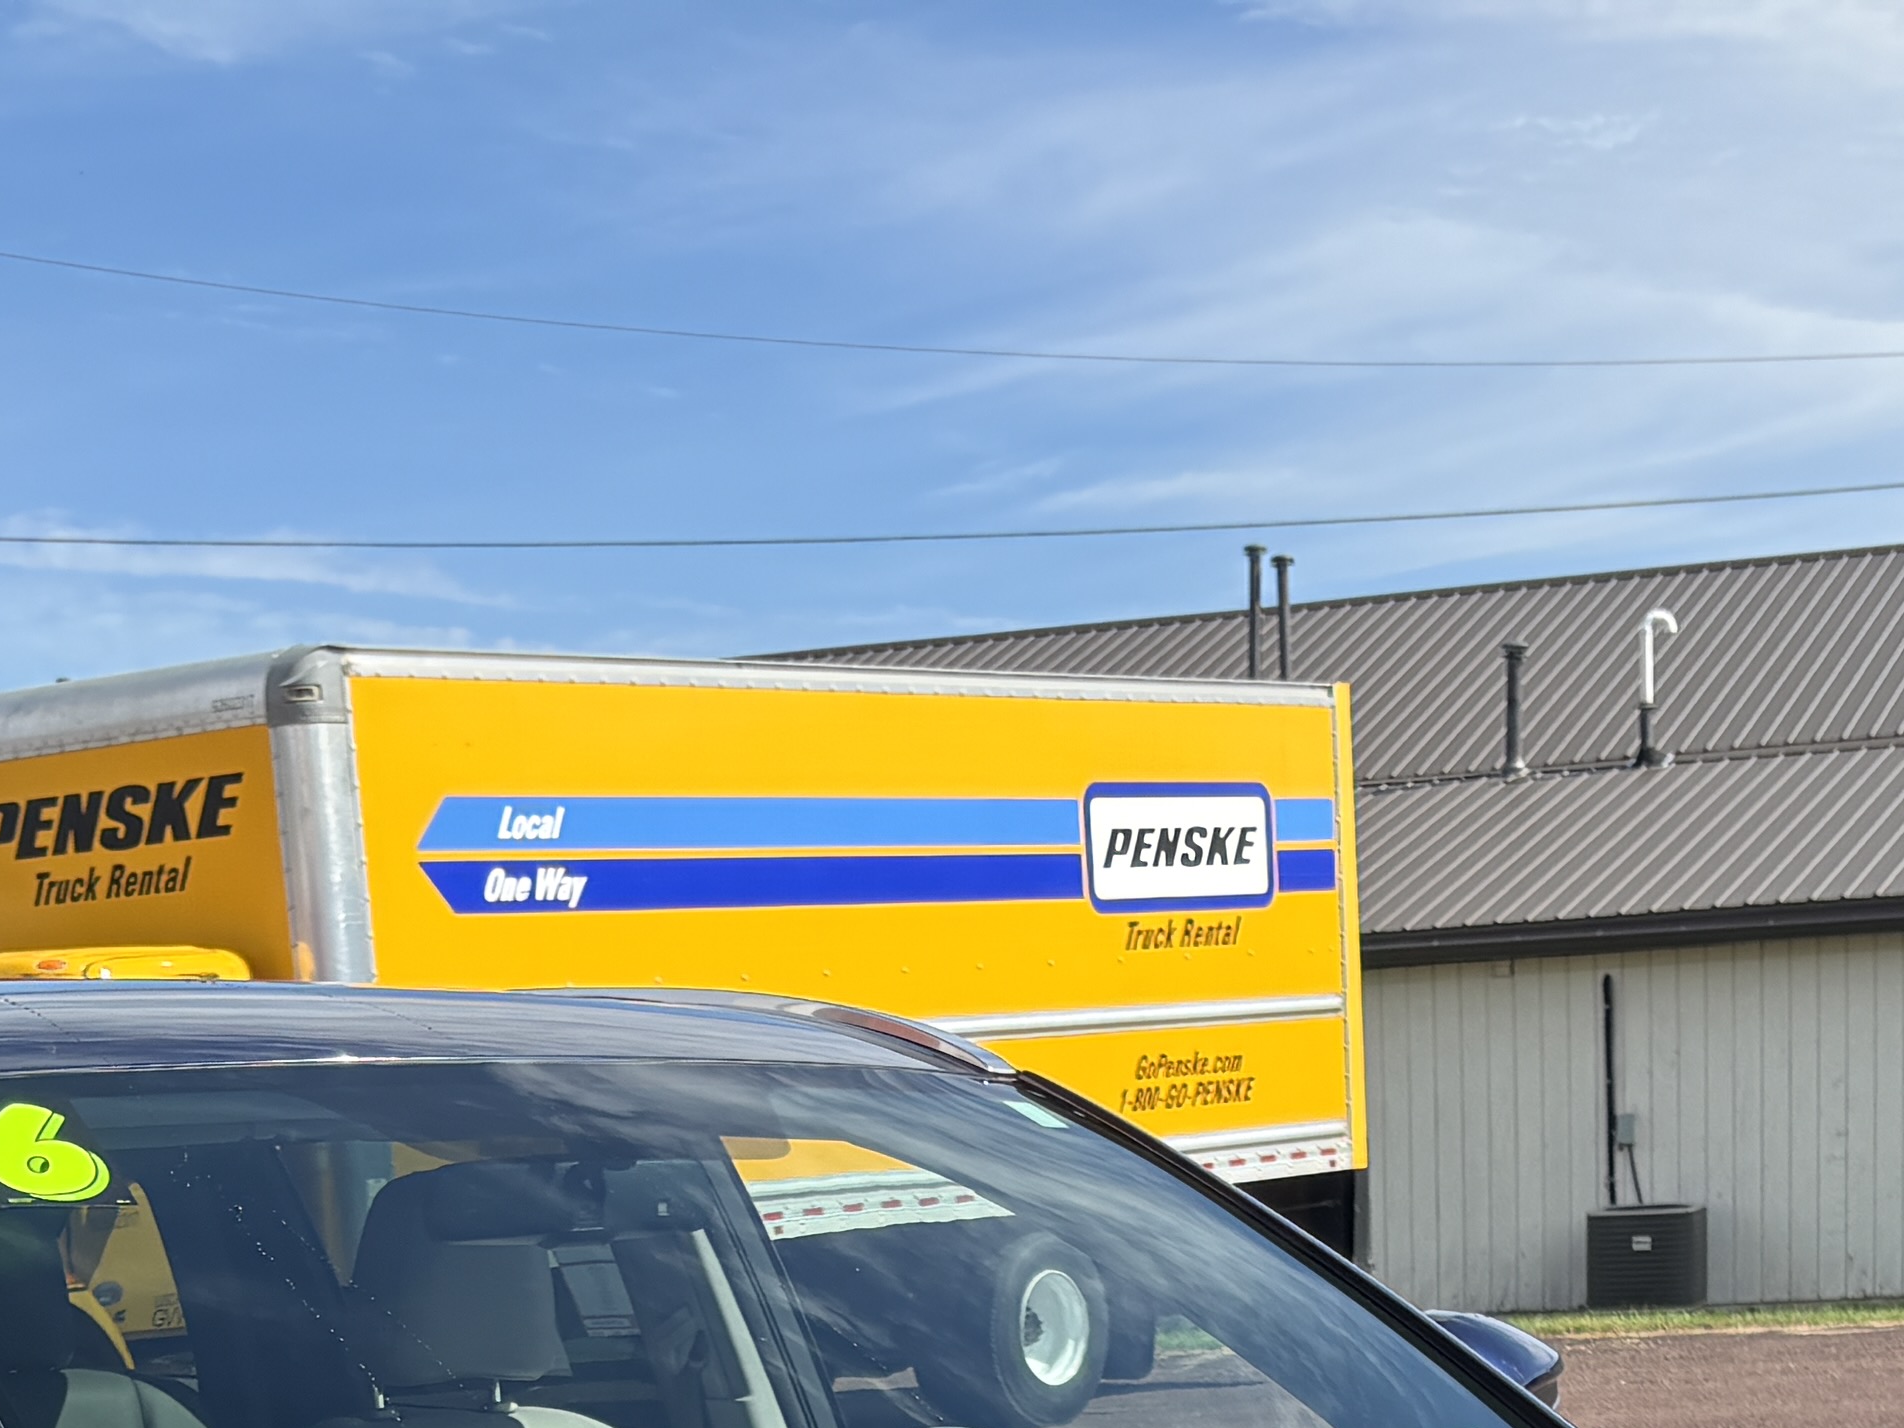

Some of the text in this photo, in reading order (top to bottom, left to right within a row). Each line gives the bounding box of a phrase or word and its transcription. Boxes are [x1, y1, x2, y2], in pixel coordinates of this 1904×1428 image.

[497, 805, 566, 841] Local
[1103, 826, 1258, 869] PENSKE
[33, 855, 193, 907] Truck Rental
[483, 867, 589, 908] One Way
[1124, 916, 1243, 951] Truck Rental
[1134, 1050, 1244, 1081] GoPenske.com
[1119, 1076, 1256, 1114] 1-800-GO-PENSKE
